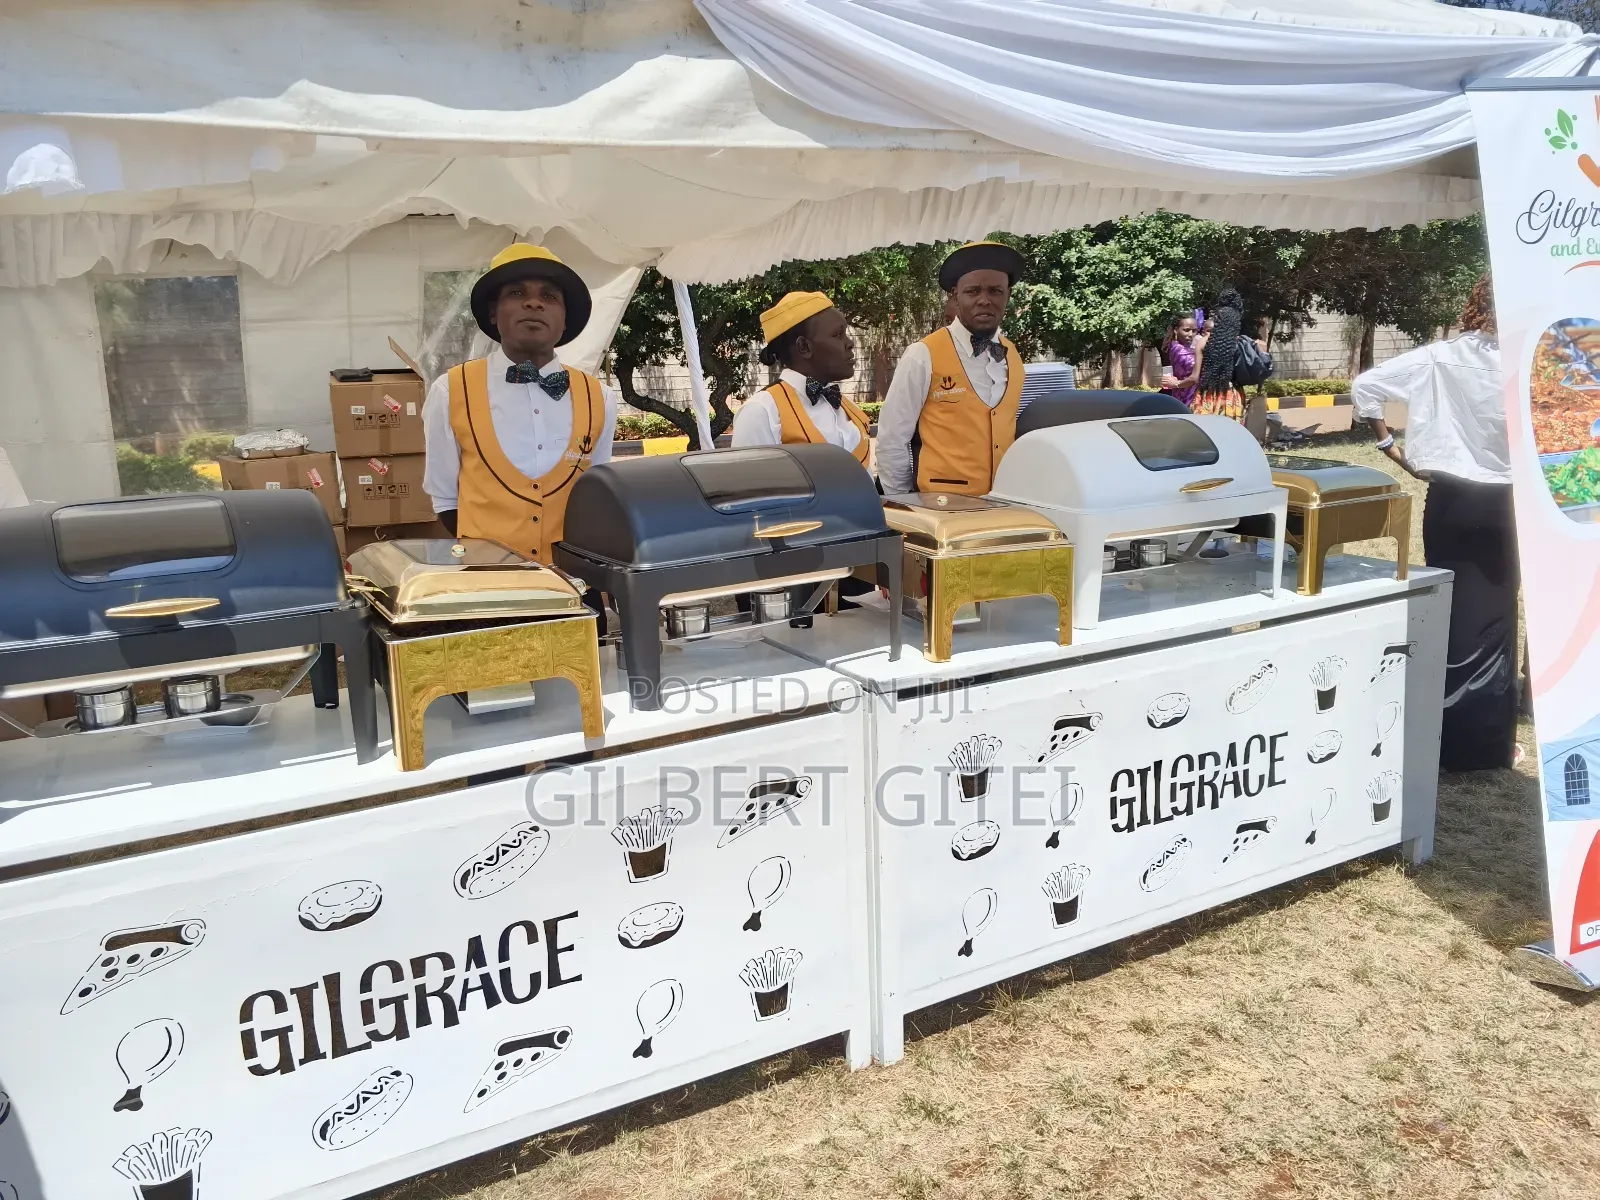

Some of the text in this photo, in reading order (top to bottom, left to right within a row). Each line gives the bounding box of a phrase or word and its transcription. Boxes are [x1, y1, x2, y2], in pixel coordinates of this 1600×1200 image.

[1550, 236, 1583, 257] and
[1110, 731, 1289, 834] GILGRACE
[239, 911, 582, 1077] GILGRACE
